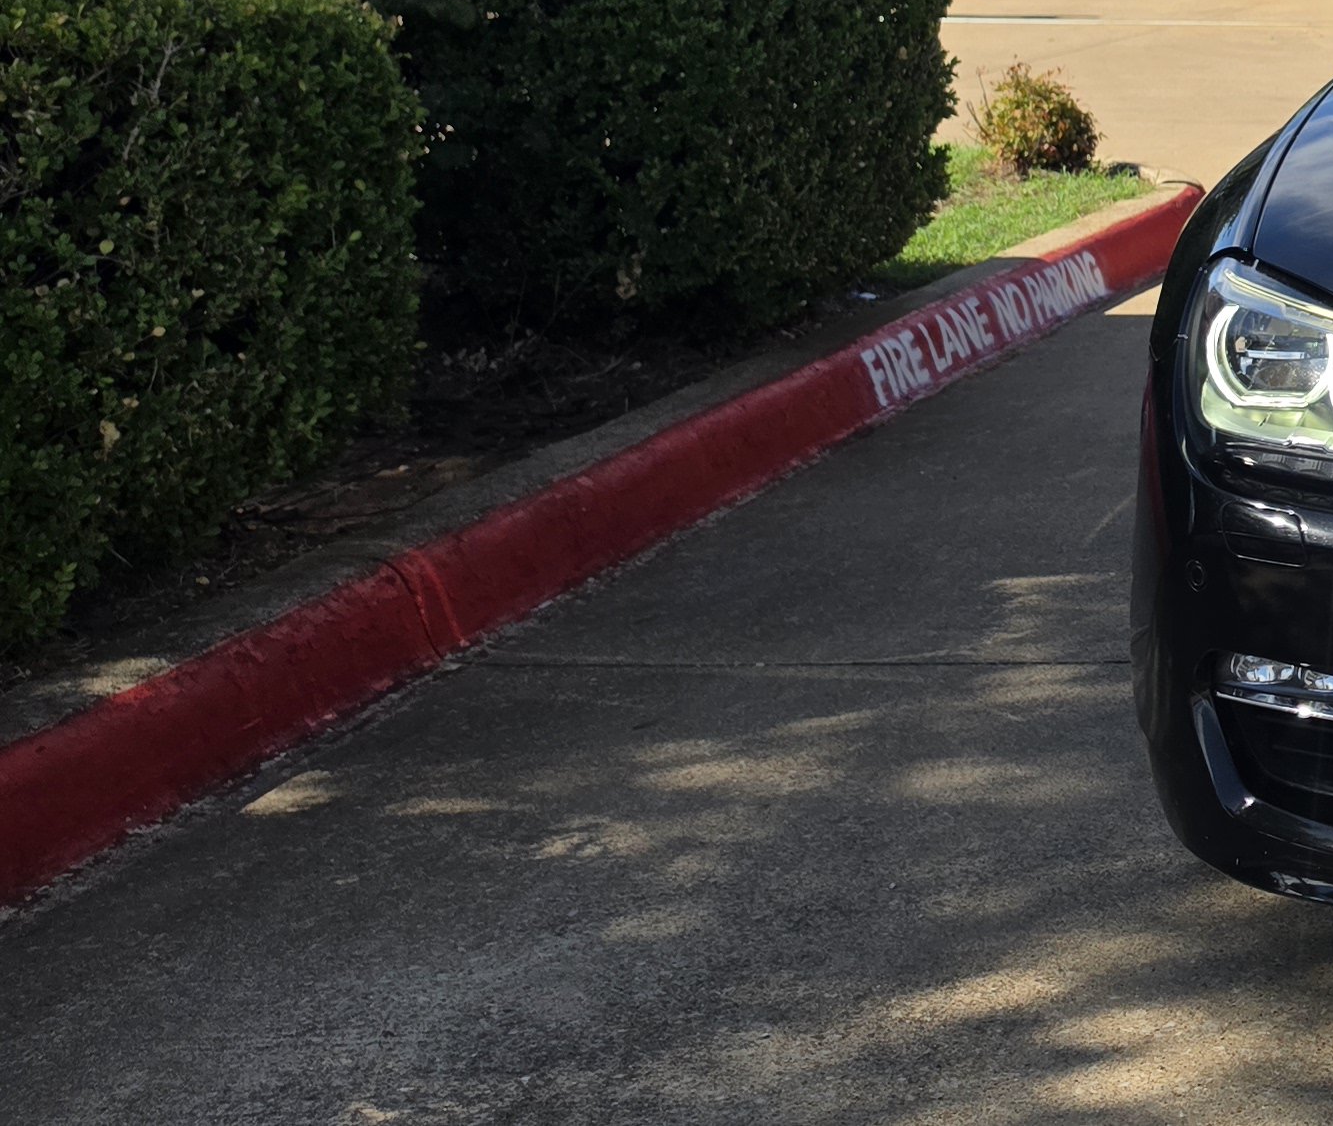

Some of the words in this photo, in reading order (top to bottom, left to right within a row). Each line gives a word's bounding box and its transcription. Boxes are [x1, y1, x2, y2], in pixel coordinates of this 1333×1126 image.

[860, 328, 933, 407] FIRE
[918, 297, 994, 373] LANE
[987, 283, 1031, 341] NO
[1023, 251, 1107, 324] PARKING
